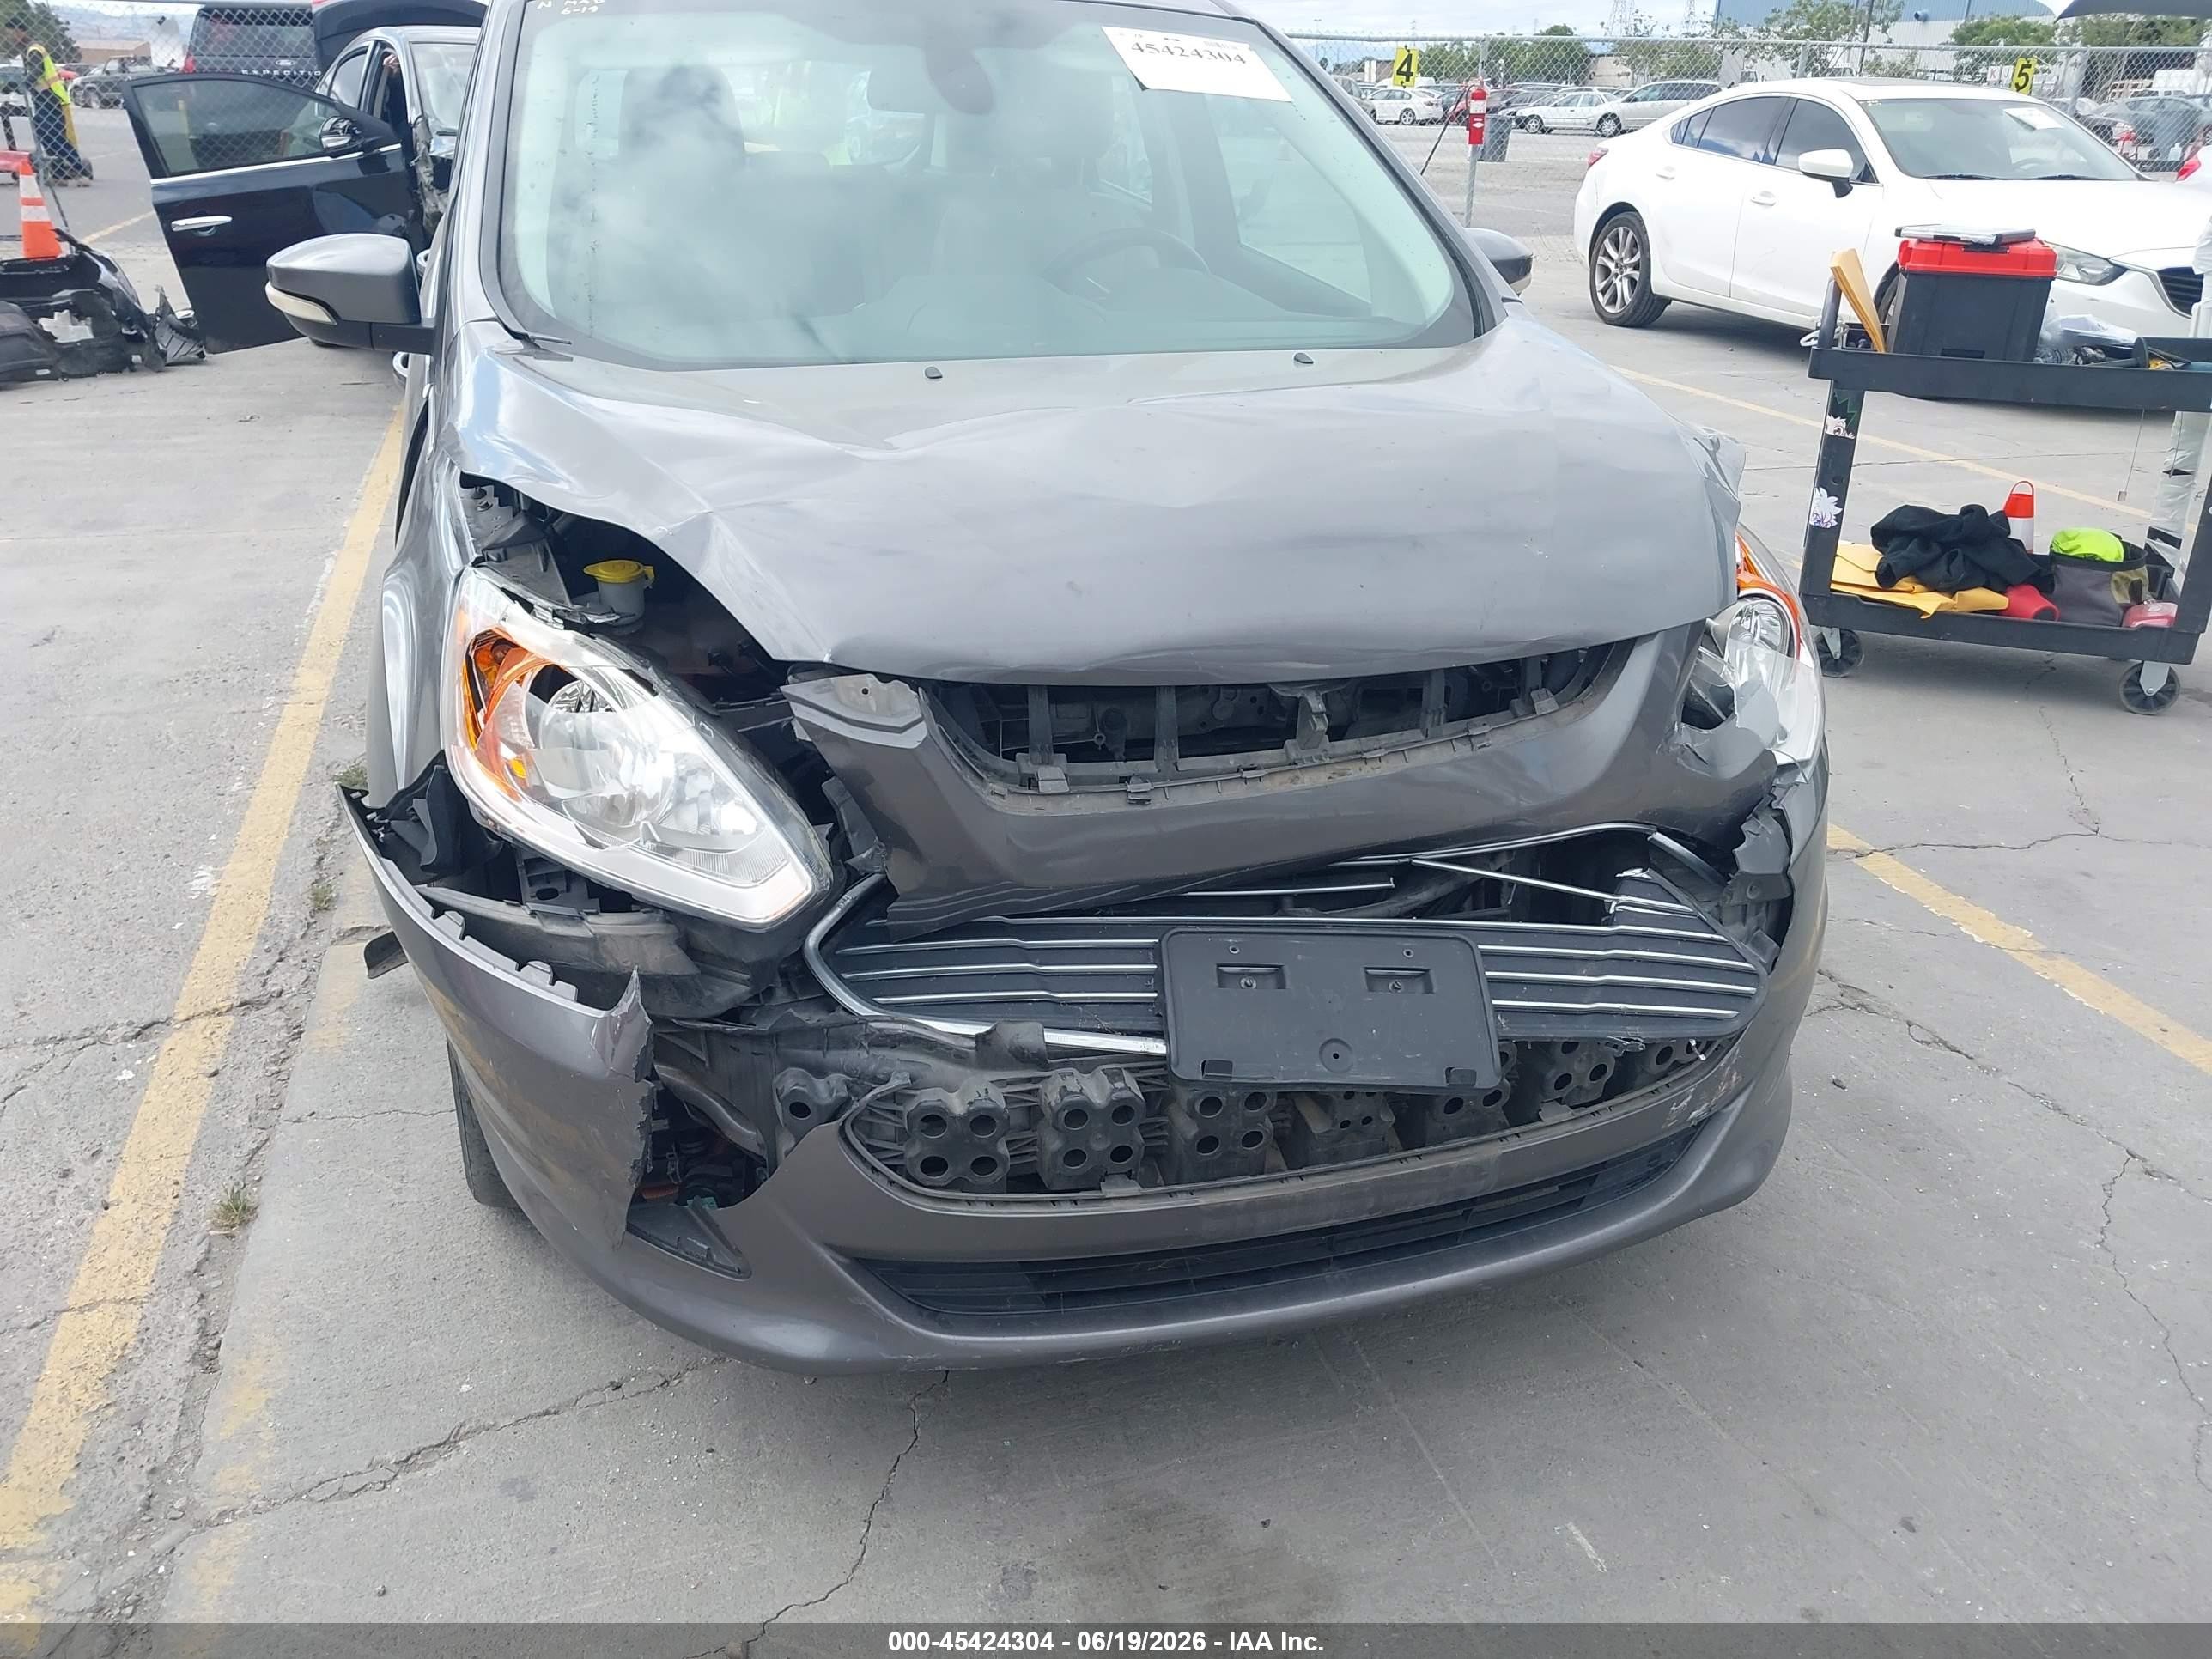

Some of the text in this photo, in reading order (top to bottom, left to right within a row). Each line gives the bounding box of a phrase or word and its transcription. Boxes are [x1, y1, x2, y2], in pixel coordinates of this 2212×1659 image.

[1130, 41, 1248, 65] 45424304
[1395, 52, 1414, 82] 4
[2014, 63, 2033, 92] 5
